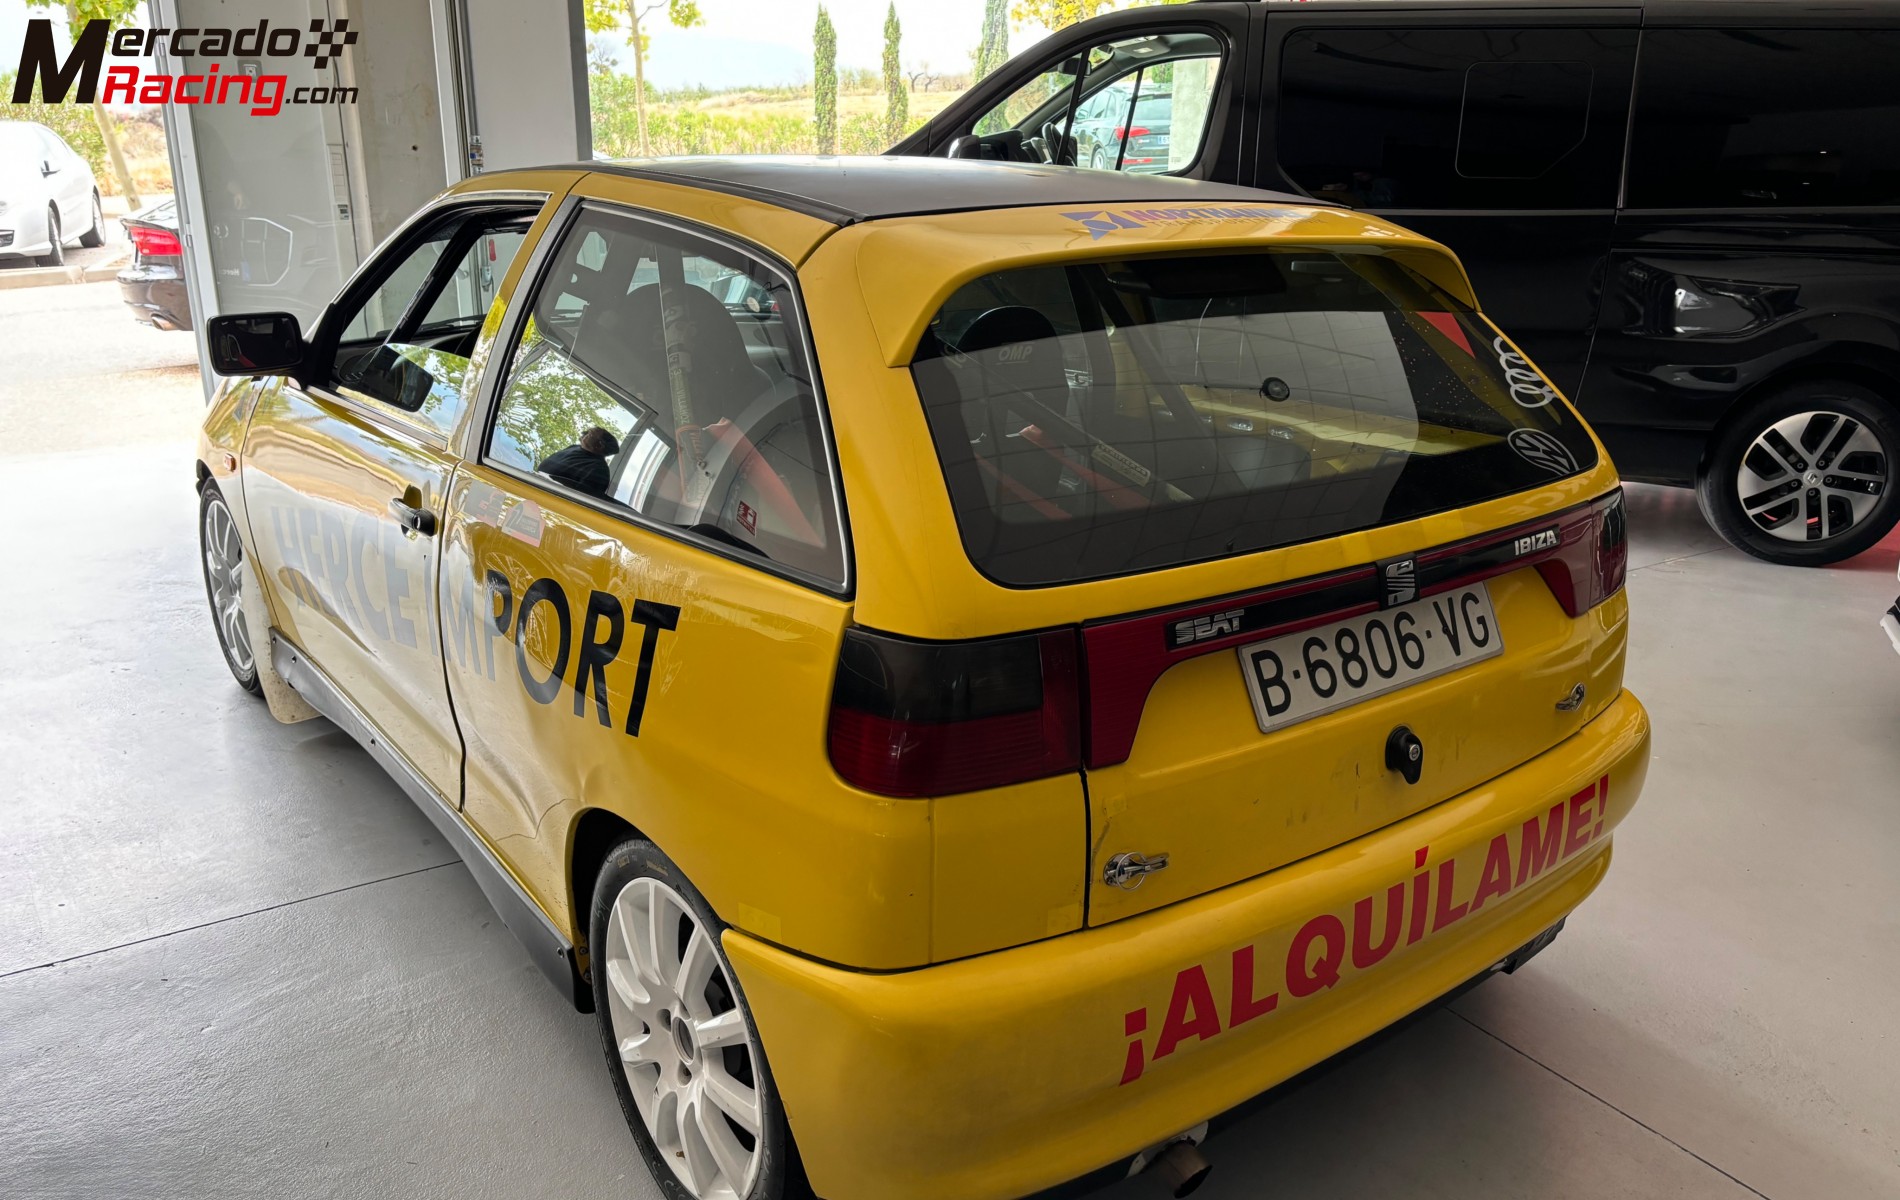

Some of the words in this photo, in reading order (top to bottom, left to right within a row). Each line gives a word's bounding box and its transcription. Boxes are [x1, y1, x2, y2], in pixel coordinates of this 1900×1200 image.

[998, 345, 1033, 361] OMP
[1514, 529, 1557, 556] IBIZA
[271, 505, 418, 649] HERCE
[423, 554, 681, 738] IMPORT
[1175, 609, 1245, 645] SEAT
[1119, 774, 1610, 1087] ¡ALQUÍLAME!
